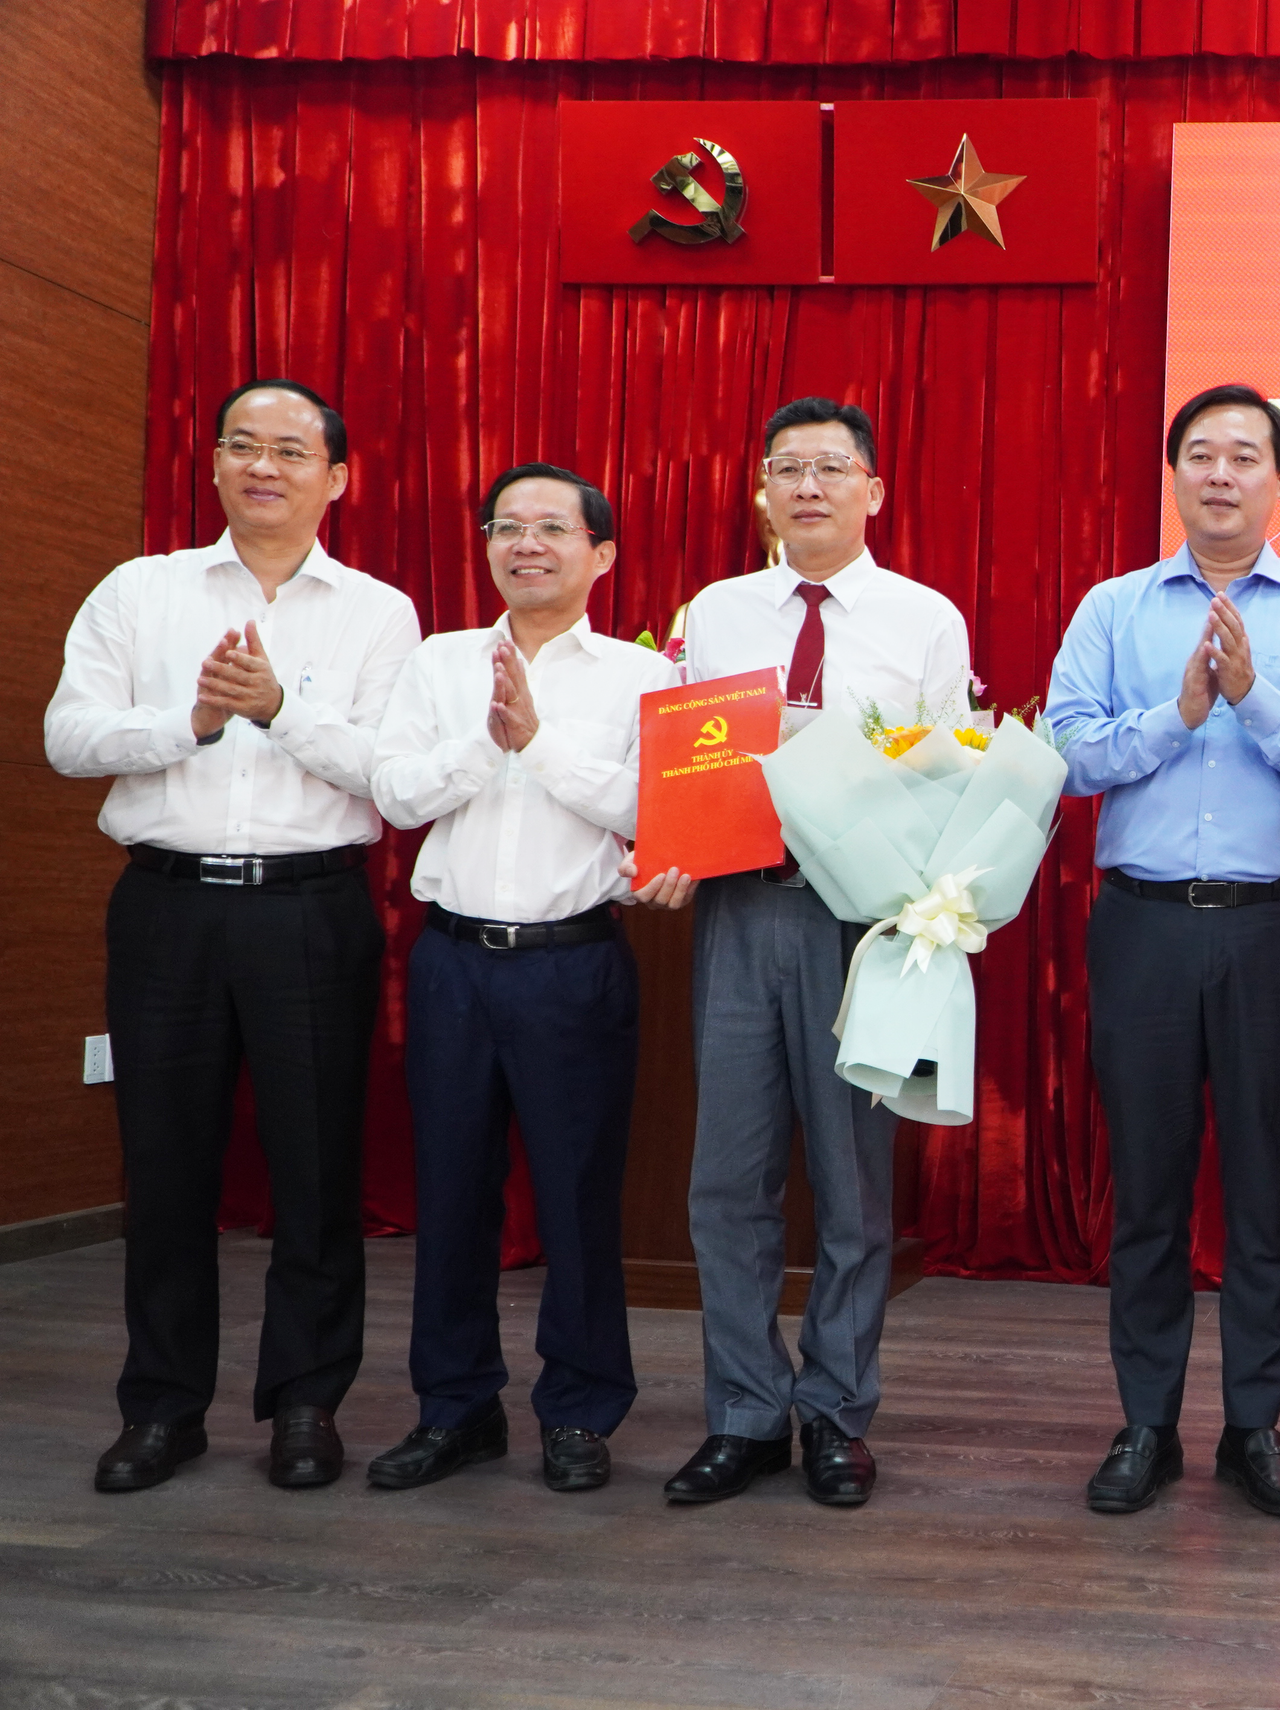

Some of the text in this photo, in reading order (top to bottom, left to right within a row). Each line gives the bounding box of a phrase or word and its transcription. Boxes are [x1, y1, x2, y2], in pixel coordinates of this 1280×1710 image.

[658, 686, 766, 715] ĐẢNG CỘNG SẢN VIỆT NAM
[661, 767, 691, 778] THÀNH
[691, 761, 710, 773] PHỐ
[710, 759, 724, 770] HỒ
[724, 756, 740, 767] CHÍ
[691, 752, 721, 763] THÀNH
